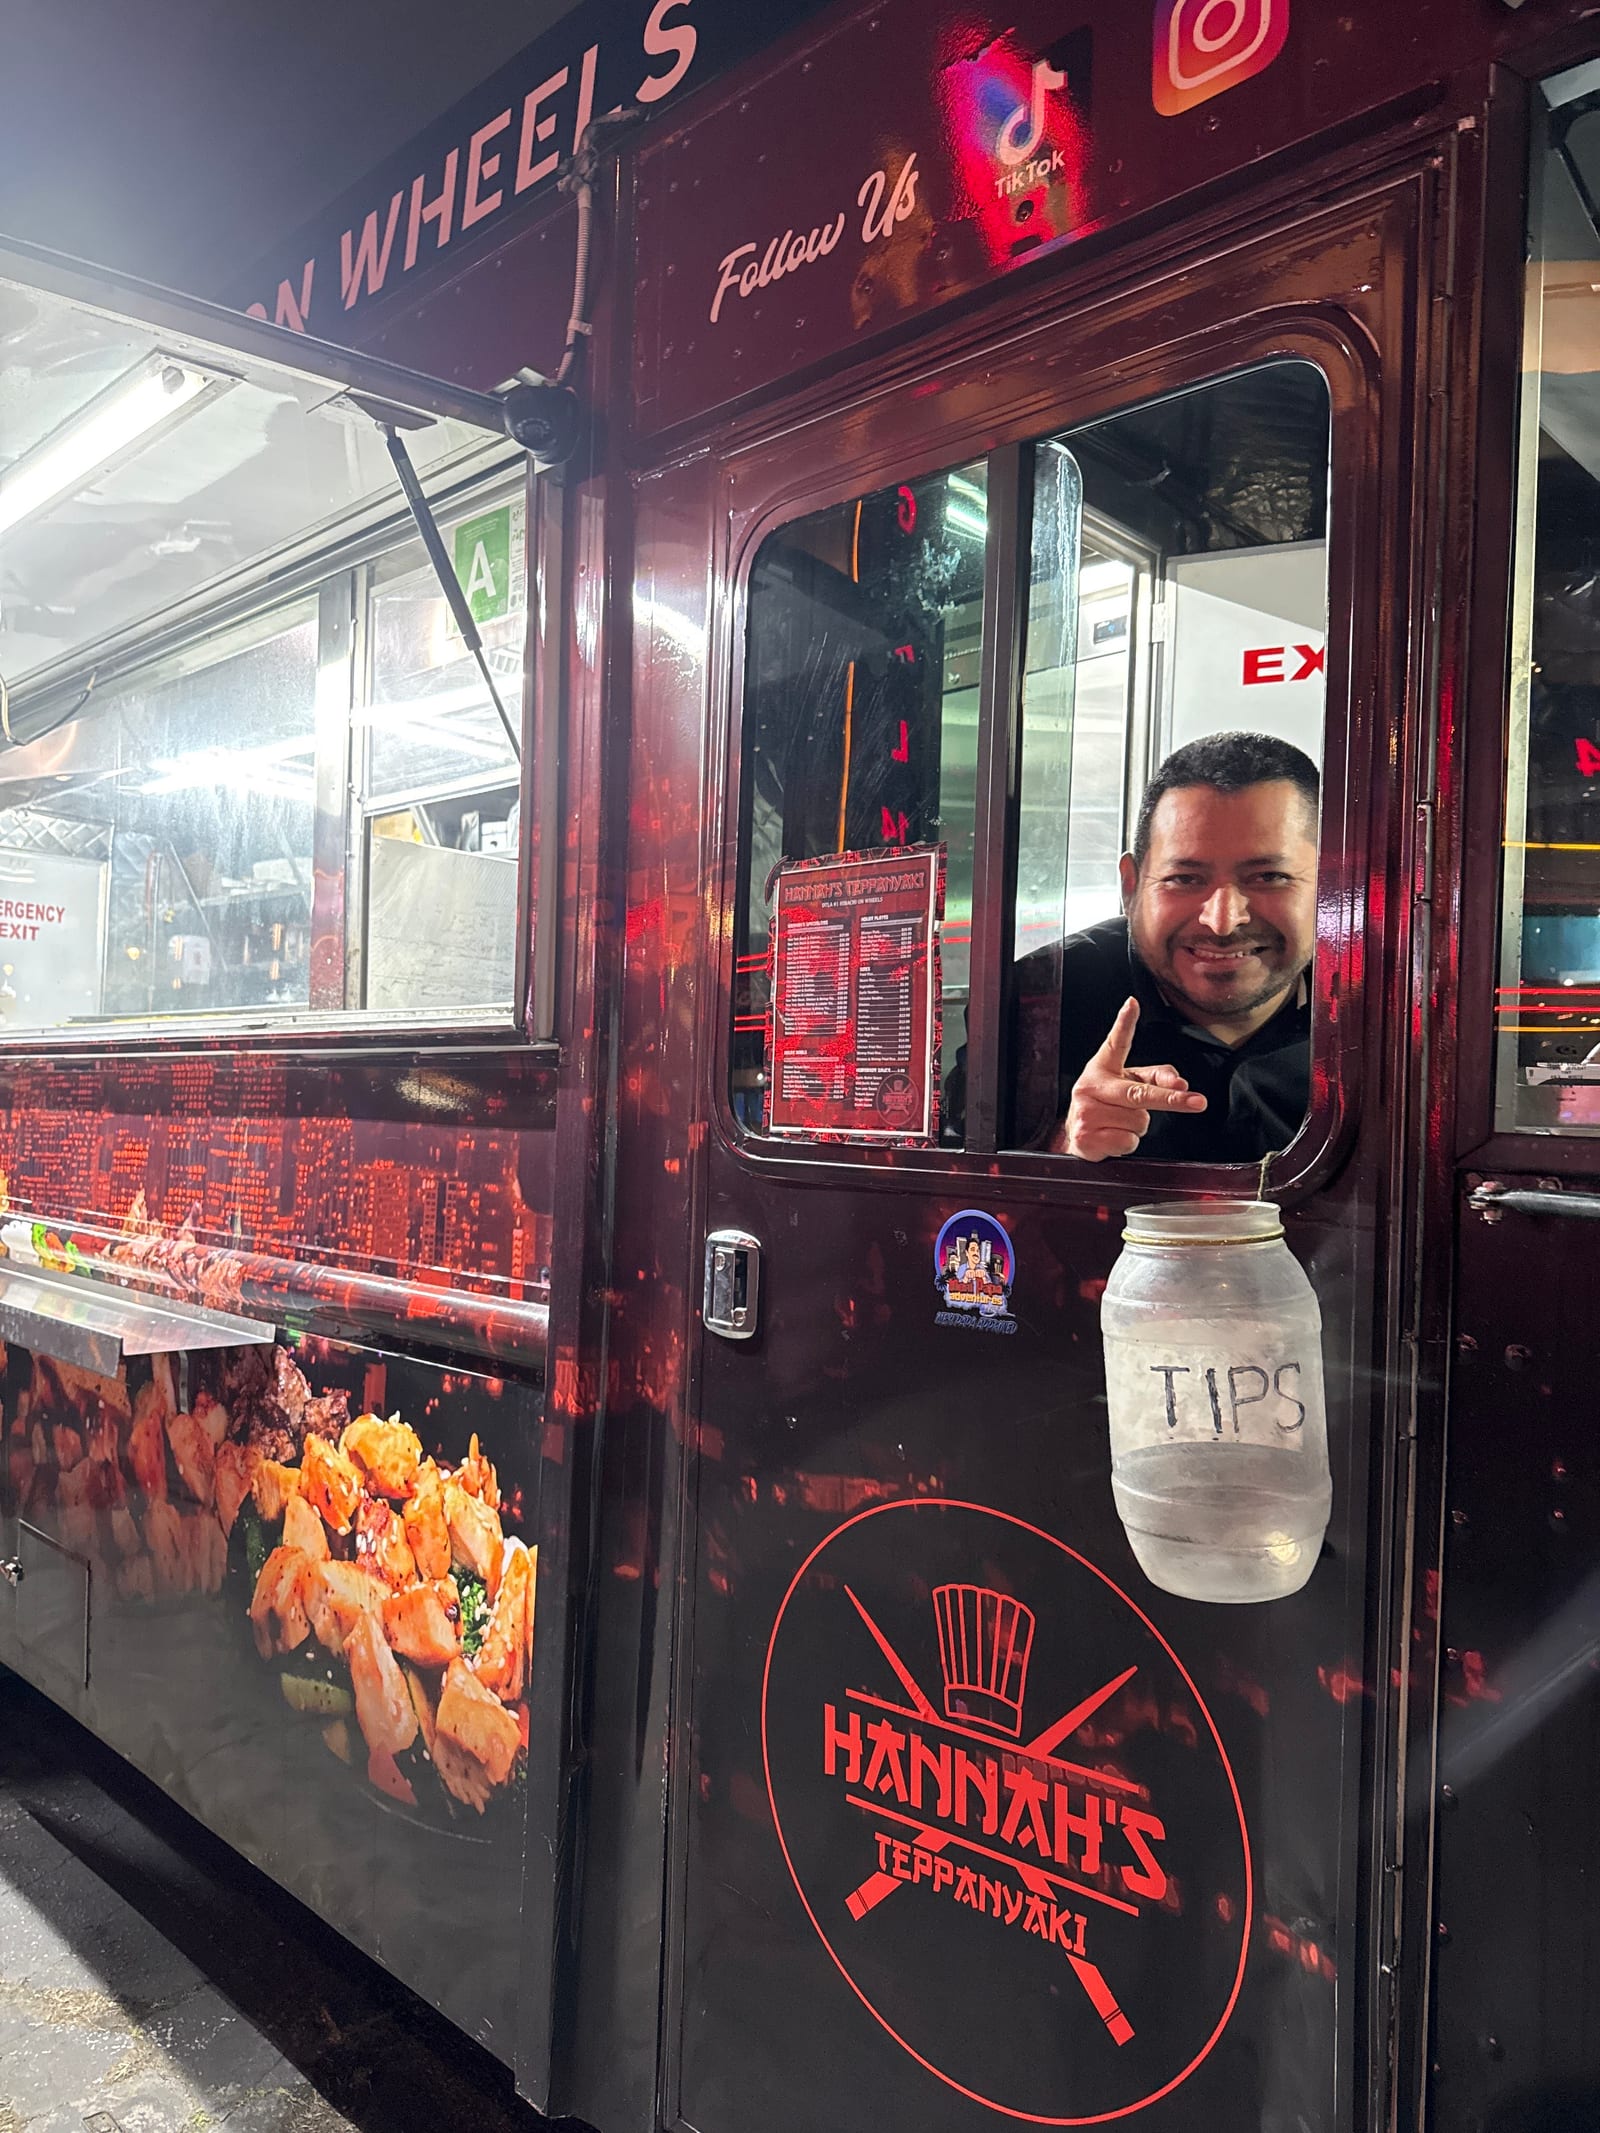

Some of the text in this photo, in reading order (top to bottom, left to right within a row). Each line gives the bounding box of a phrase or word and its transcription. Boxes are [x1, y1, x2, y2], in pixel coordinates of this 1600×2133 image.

[341, 0, 697, 311] WHEELS
[994, 149, 1066, 199] TikTok
[711, 151, 919, 323] Follow Us
[466, 540, 497, 606] A
[785, 873, 924, 901] HANNAH'S TEPPANYAKI
[0, 922, 40, 941] EXIT
[1150, 1362, 1306, 1434] TIPS
[823, 1702, 1167, 1900] HANNAH'S
[874, 1831, 1088, 1957] TEPPANYAKI
